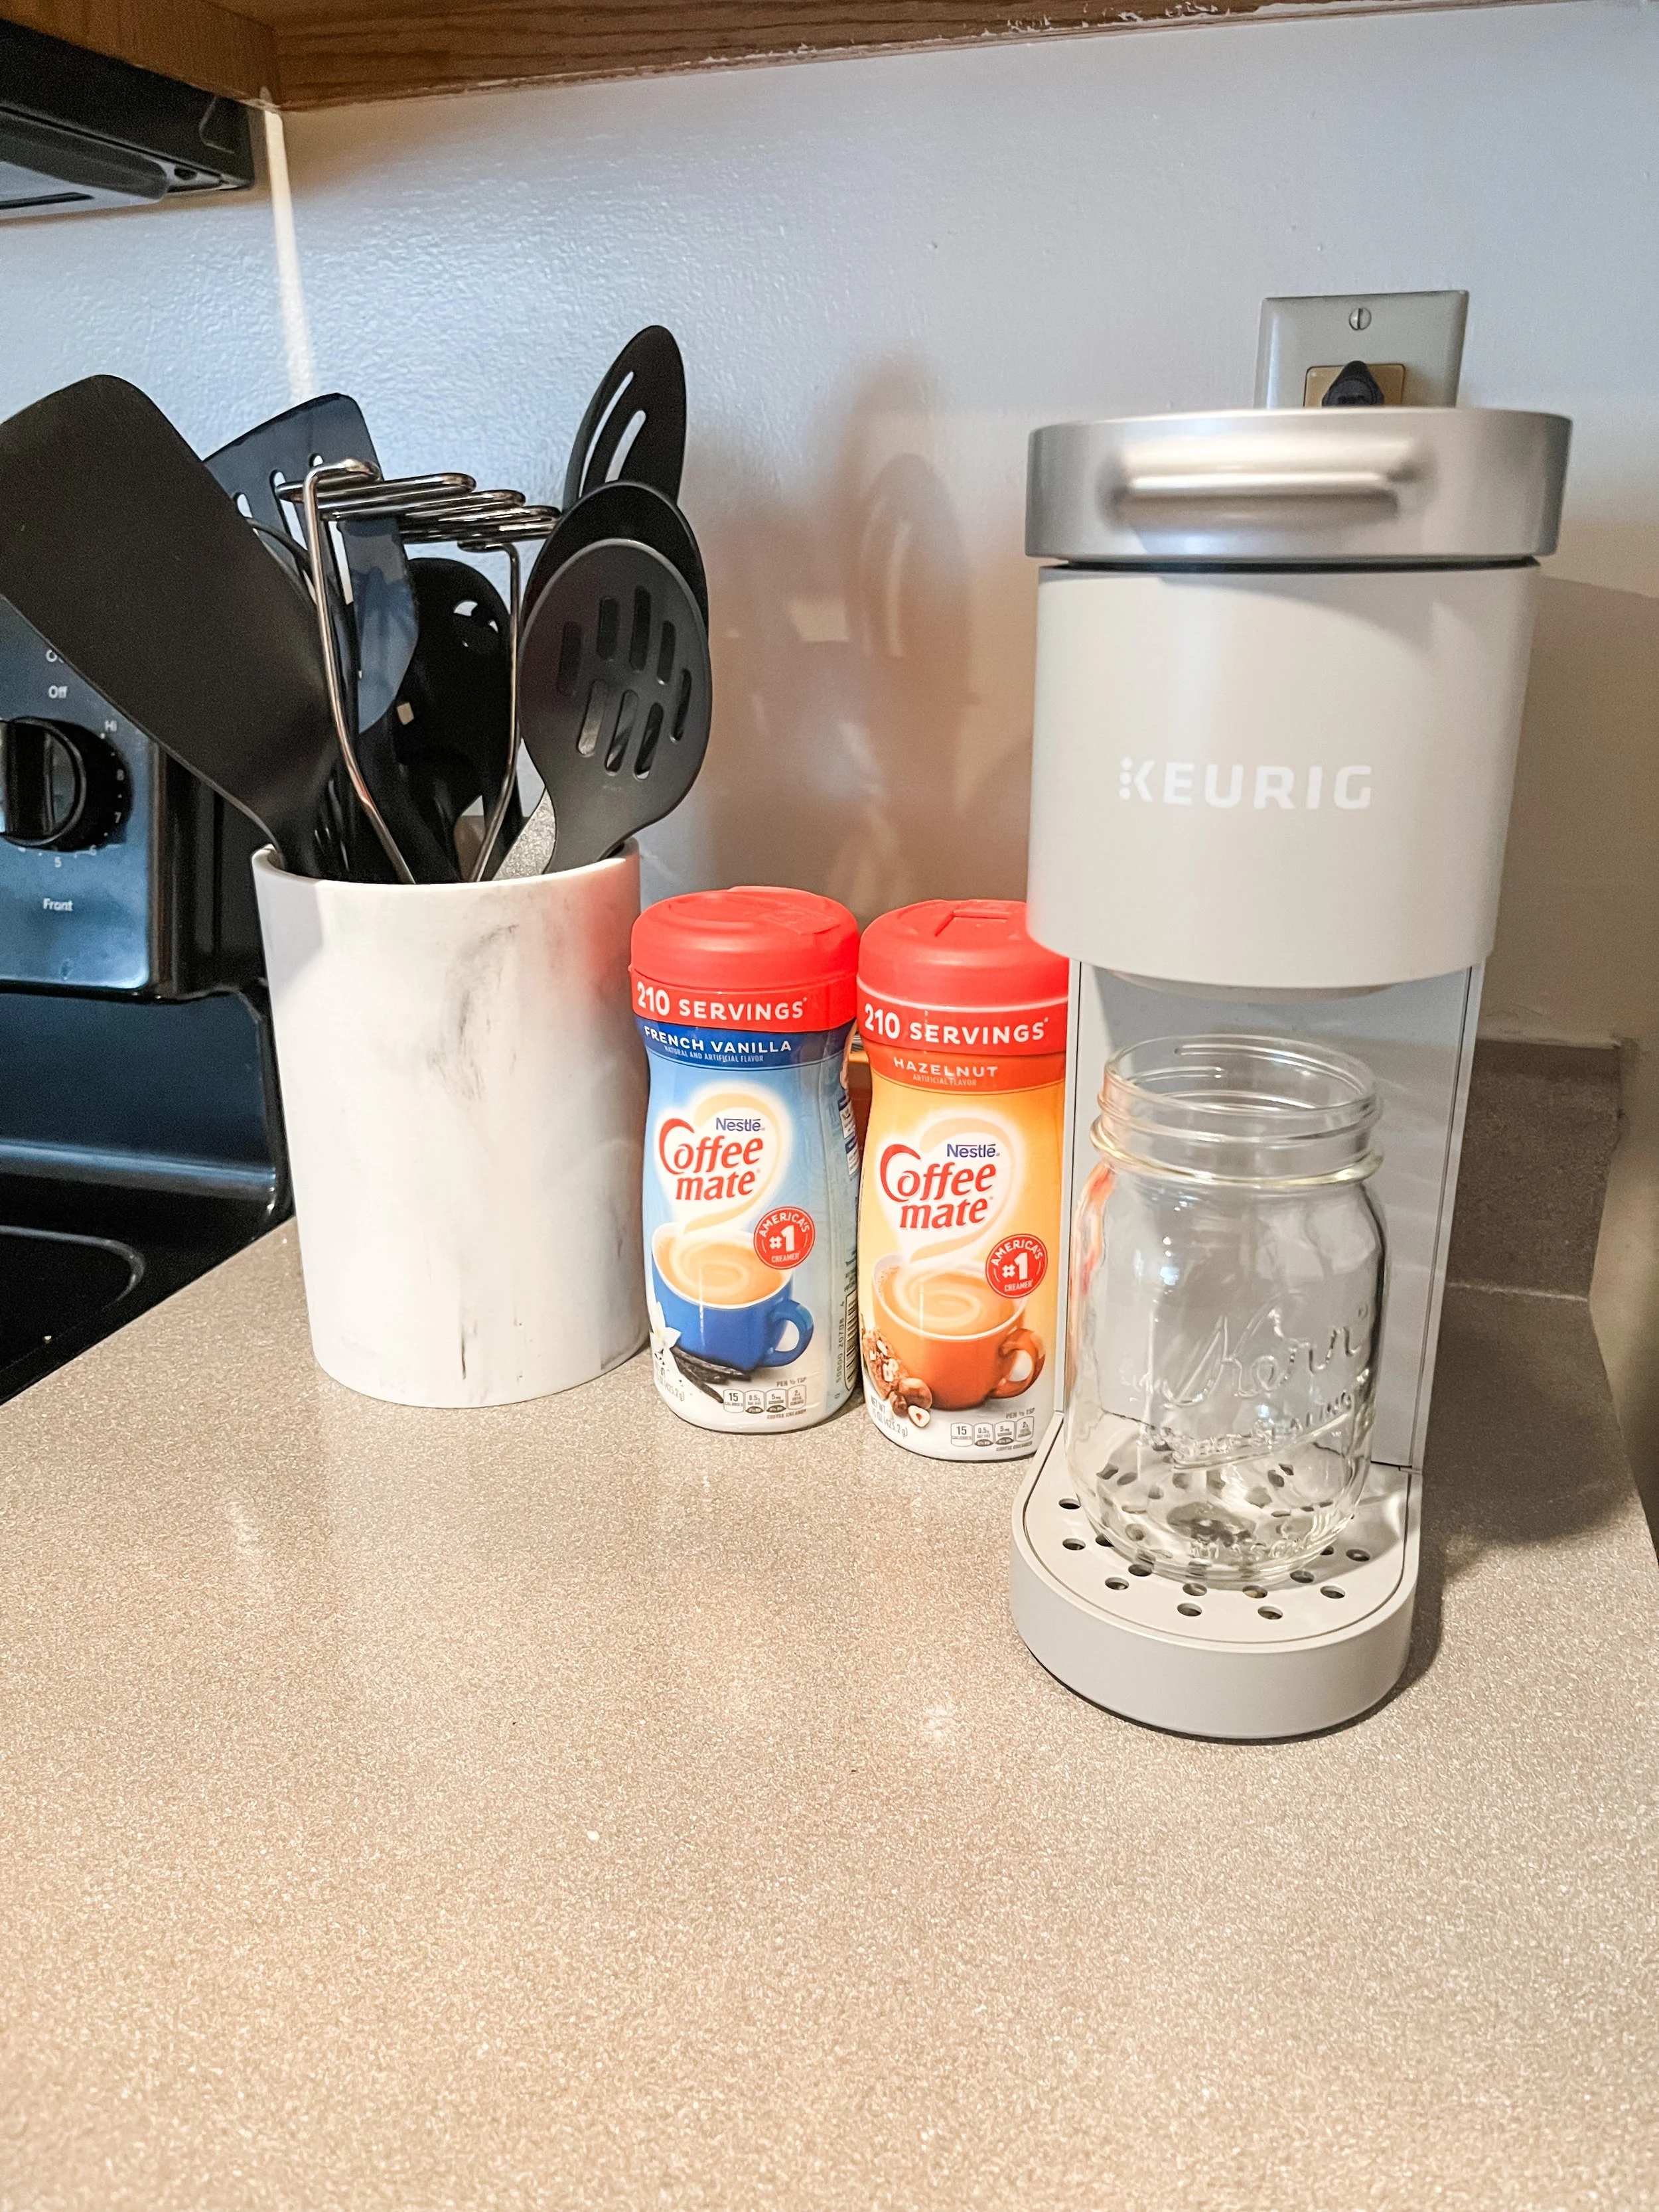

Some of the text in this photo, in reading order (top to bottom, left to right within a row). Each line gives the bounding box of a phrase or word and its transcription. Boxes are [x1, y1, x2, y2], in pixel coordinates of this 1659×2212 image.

[48, 686, 68, 699] Off
[104, 720, 117, 732] Hi
[1119, 757, 1372, 810] KEURIG
[114, 812, 122, 823] 7
[54, 856, 62, 867] 5
[43, 897, 74, 912] Front
[637, 981, 670, 1016] 210
[865, 1003, 901, 1040] 210
[644, 1025, 792, 1053] FRENCH VANILLA
[664, 1045, 688, 1058] NATURAL
[689, 1051, 703, 1060] AND
[704, 1053, 739, 1063] ARTIFICIAL
[893, 1057, 998, 1078] HAZELNUT
[912, 1074, 977, 1086] ARTIFICIAL FLAVOR
[659, 1118, 763, 1175] Coffee
[675, 1171, 756, 1201] mate
[880, 1143, 996, 1203] Coffee
[758, 1212, 810, 1238] AMERICA'S
[899, 1197, 989, 1229] mate
[769, 1224, 794, 1252] #1
[991, 1239, 1043, 1266] AMERICA'S
[1001, 1252, 1029, 1280] #1
[729, 1392, 739, 1402] 15
[956, 1426, 967, 1435] 15
